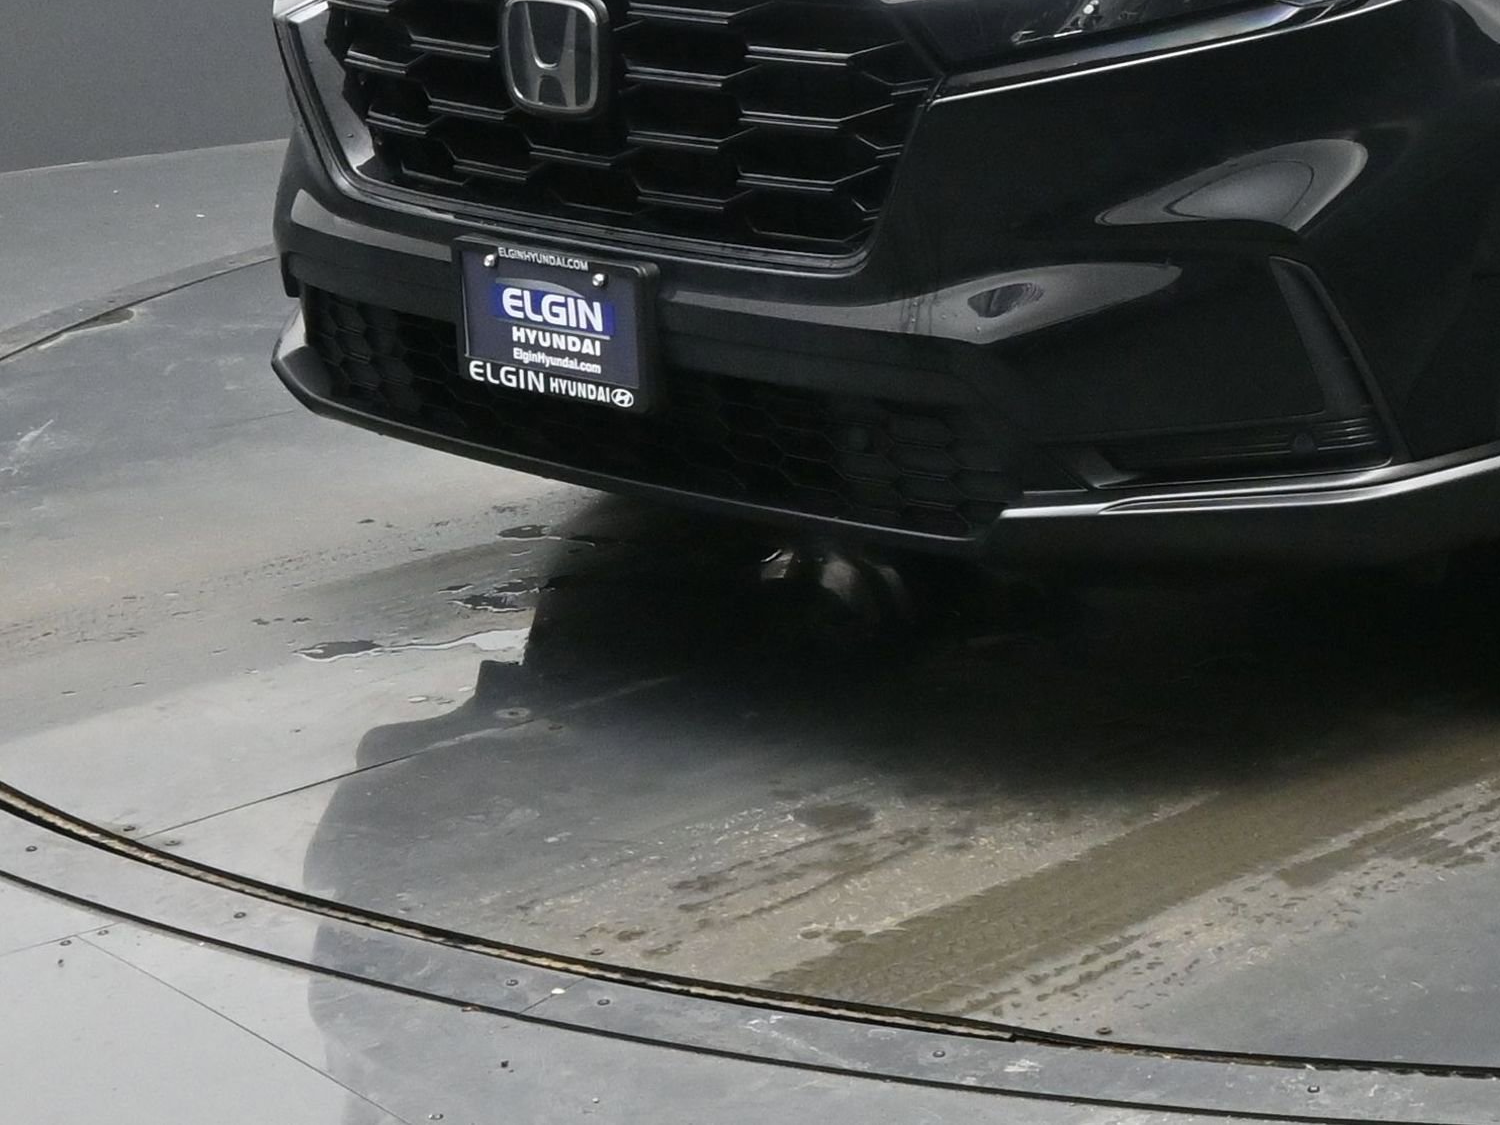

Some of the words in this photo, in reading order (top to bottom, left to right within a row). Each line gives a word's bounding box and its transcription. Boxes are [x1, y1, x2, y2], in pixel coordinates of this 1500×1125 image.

[502, 287, 604, 332] ELGIN
[512, 326, 601, 357] HYUNDAI
[513, 347, 602, 374] ElginHyundai.com
[469, 360, 545, 393] ELGIN
[550, 377, 611, 403] HYUNDAI
